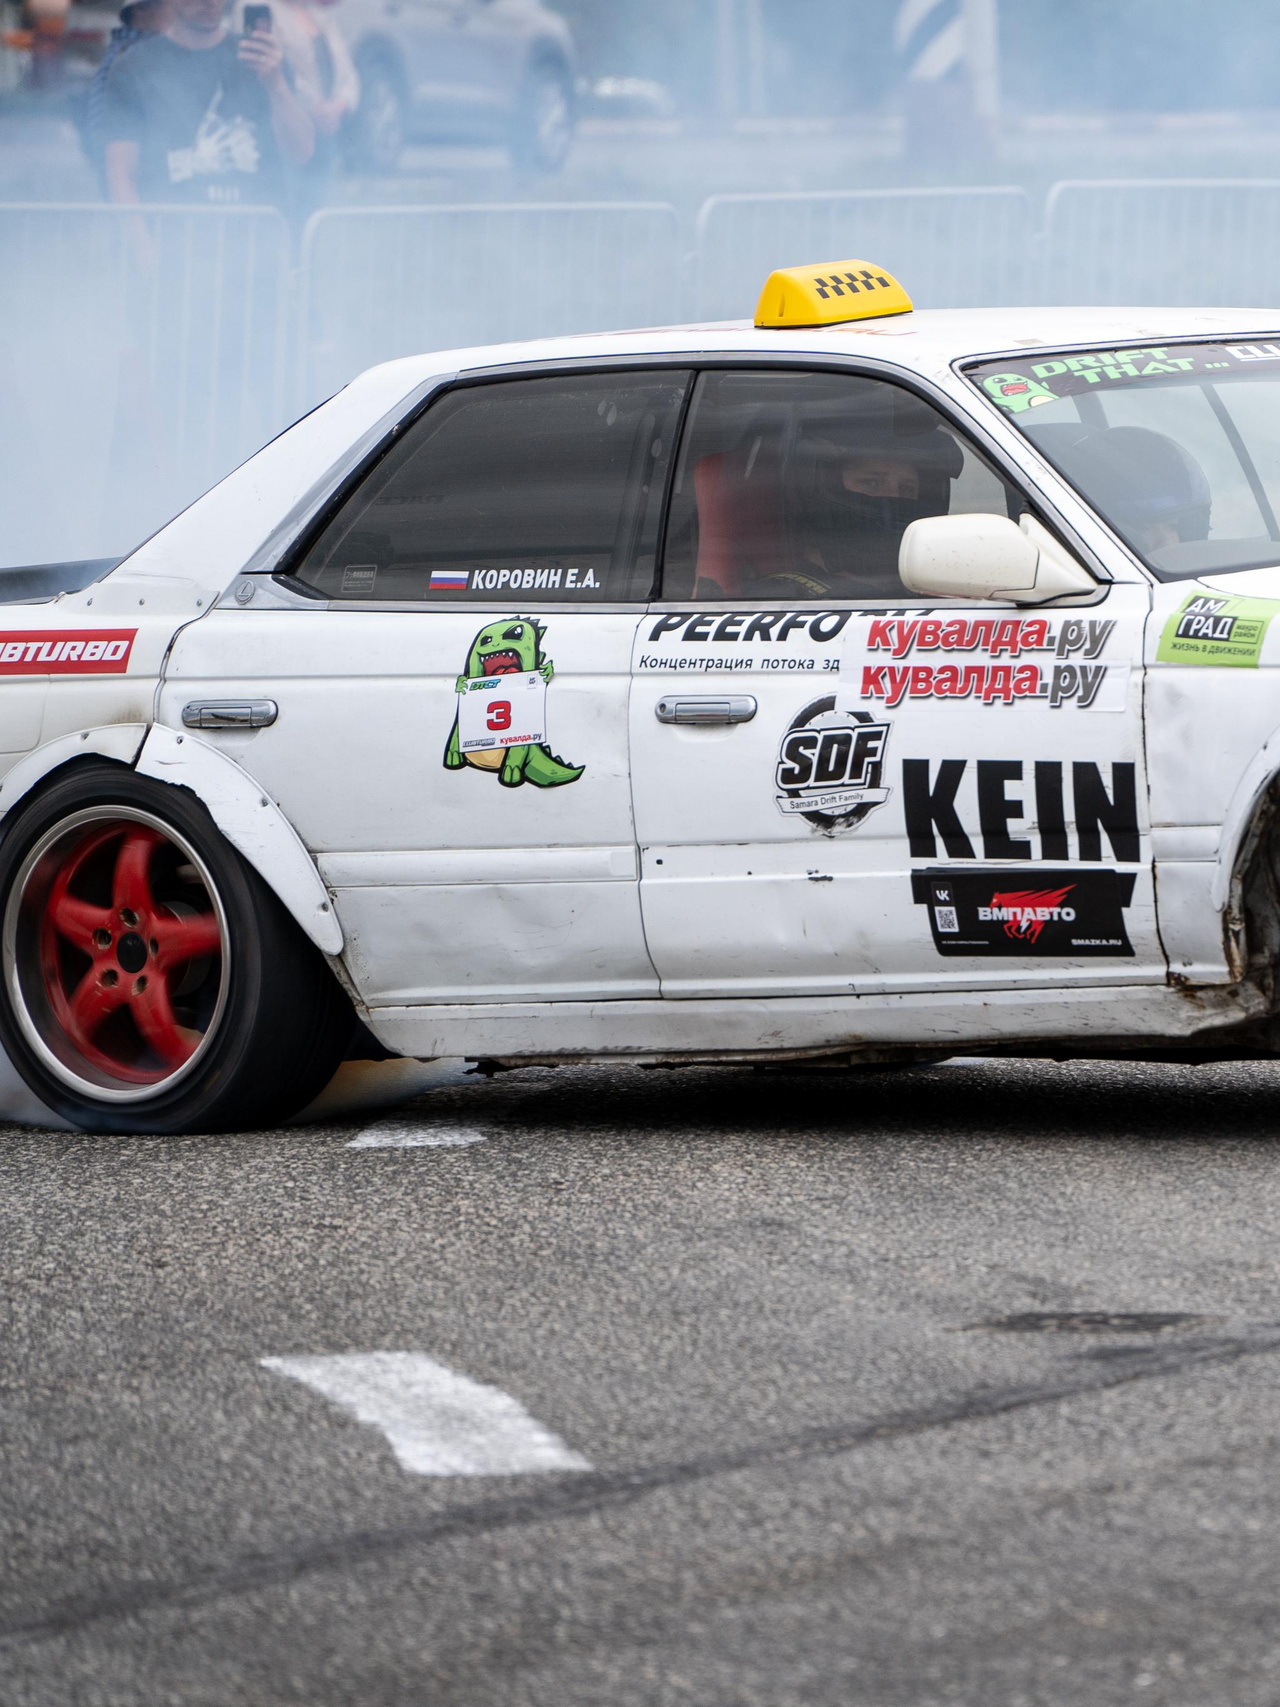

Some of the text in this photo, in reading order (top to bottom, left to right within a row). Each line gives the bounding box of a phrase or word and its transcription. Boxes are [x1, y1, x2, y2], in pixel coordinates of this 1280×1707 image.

[1030, 347, 1169, 379] DRIFT
[471, 568, 601, 590] КОРОВИН Е.А.
[1184, 597, 1228, 614] АМ
[1177, 615, 1234, 639] ГРАД
[866, 619, 1118, 659] кувалда.ру
[1171, 642, 1200, 652] ЖИЗНЬ
[1207, 645, 1256, 656] ДВИЖЕНИИ
[0, 641, 130, 663] BTURBO
[639, 655, 753, 671] Концентрация
[760, 658, 814, 670] потока
[860, 664, 1108, 709] кувалда.ру
[486, 700, 512, 731] 3
[500, 733, 542, 745] кувалда.ру
[777, 725, 889, 790] SDF
[790, 793, 864, 809] Samara Drift Family
[902, 759, 1141, 863] KEIN
[977, 906, 1076, 922] ВМПАВТО
[1071, 938, 1122, 946] SMAZKA.RU
